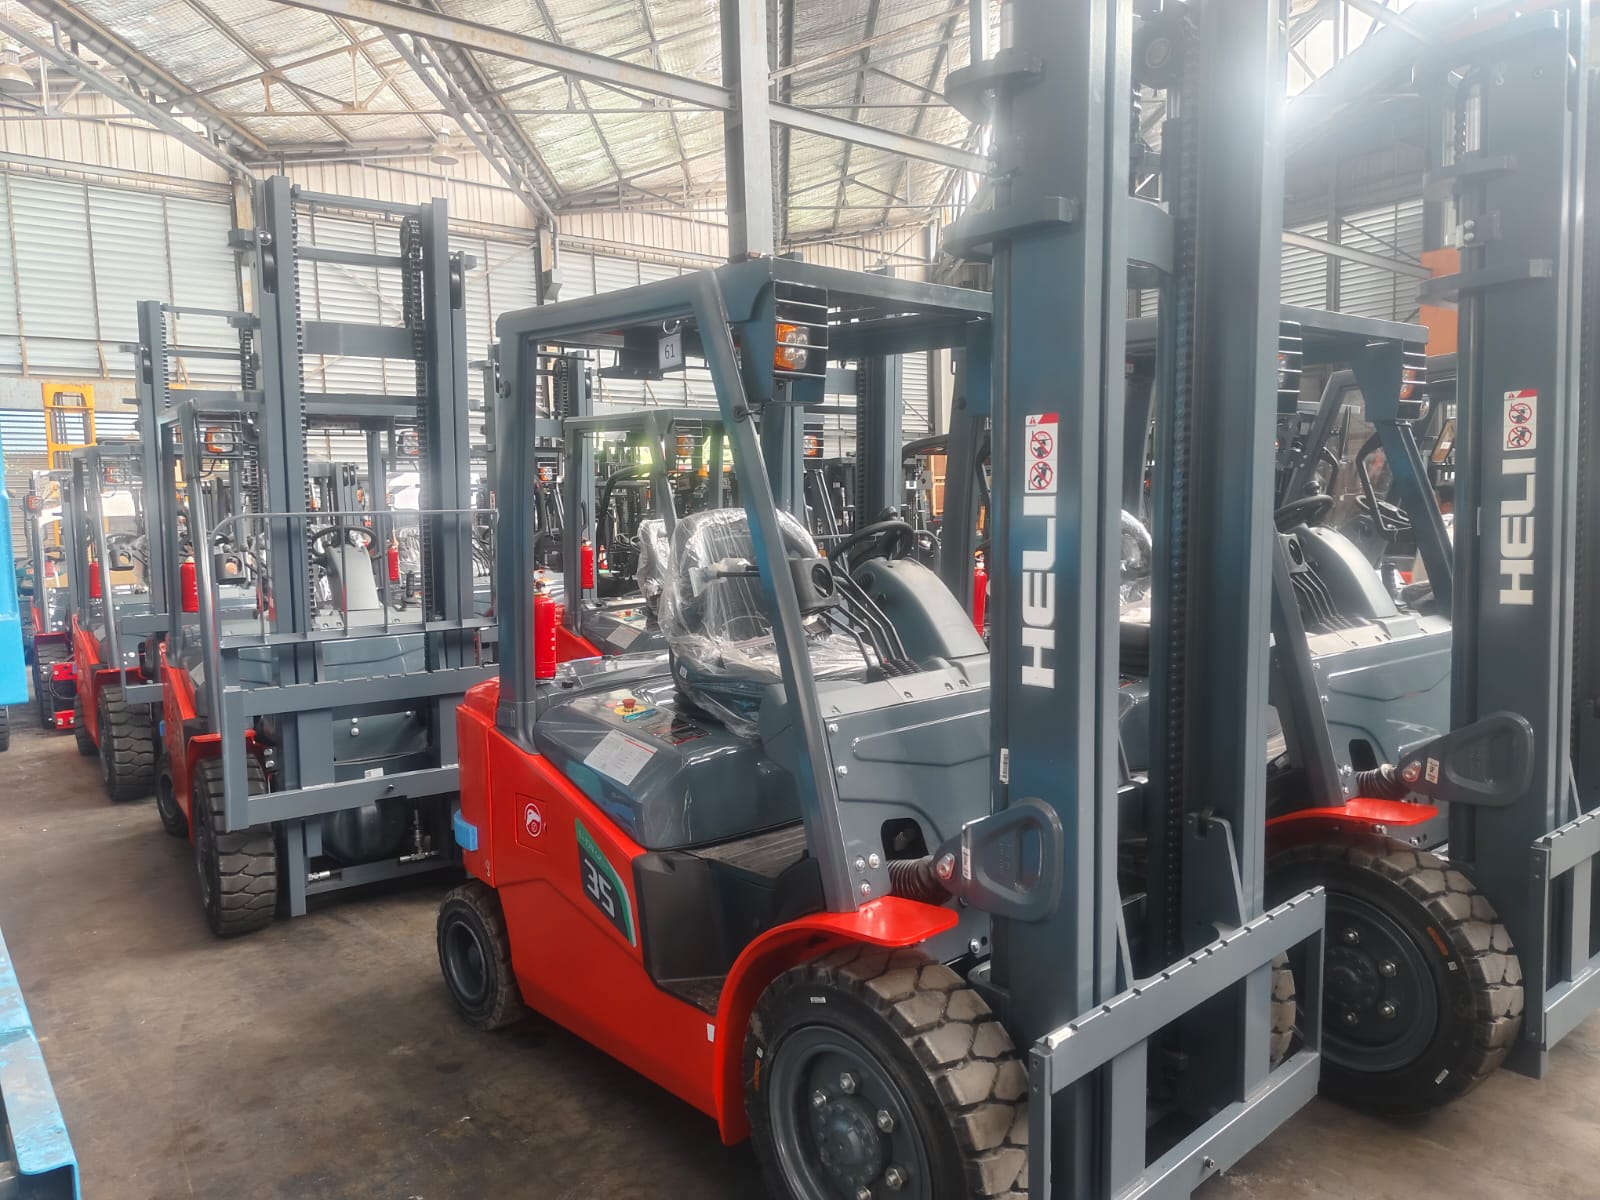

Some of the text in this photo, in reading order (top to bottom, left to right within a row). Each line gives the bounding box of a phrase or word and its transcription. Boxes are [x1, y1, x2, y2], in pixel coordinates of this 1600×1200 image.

[664, 344, 675, 360] 61
[1500, 457, 1536, 605] HELI
[1022, 495, 1056, 689] HELI
[584, 858, 615, 918] 35
